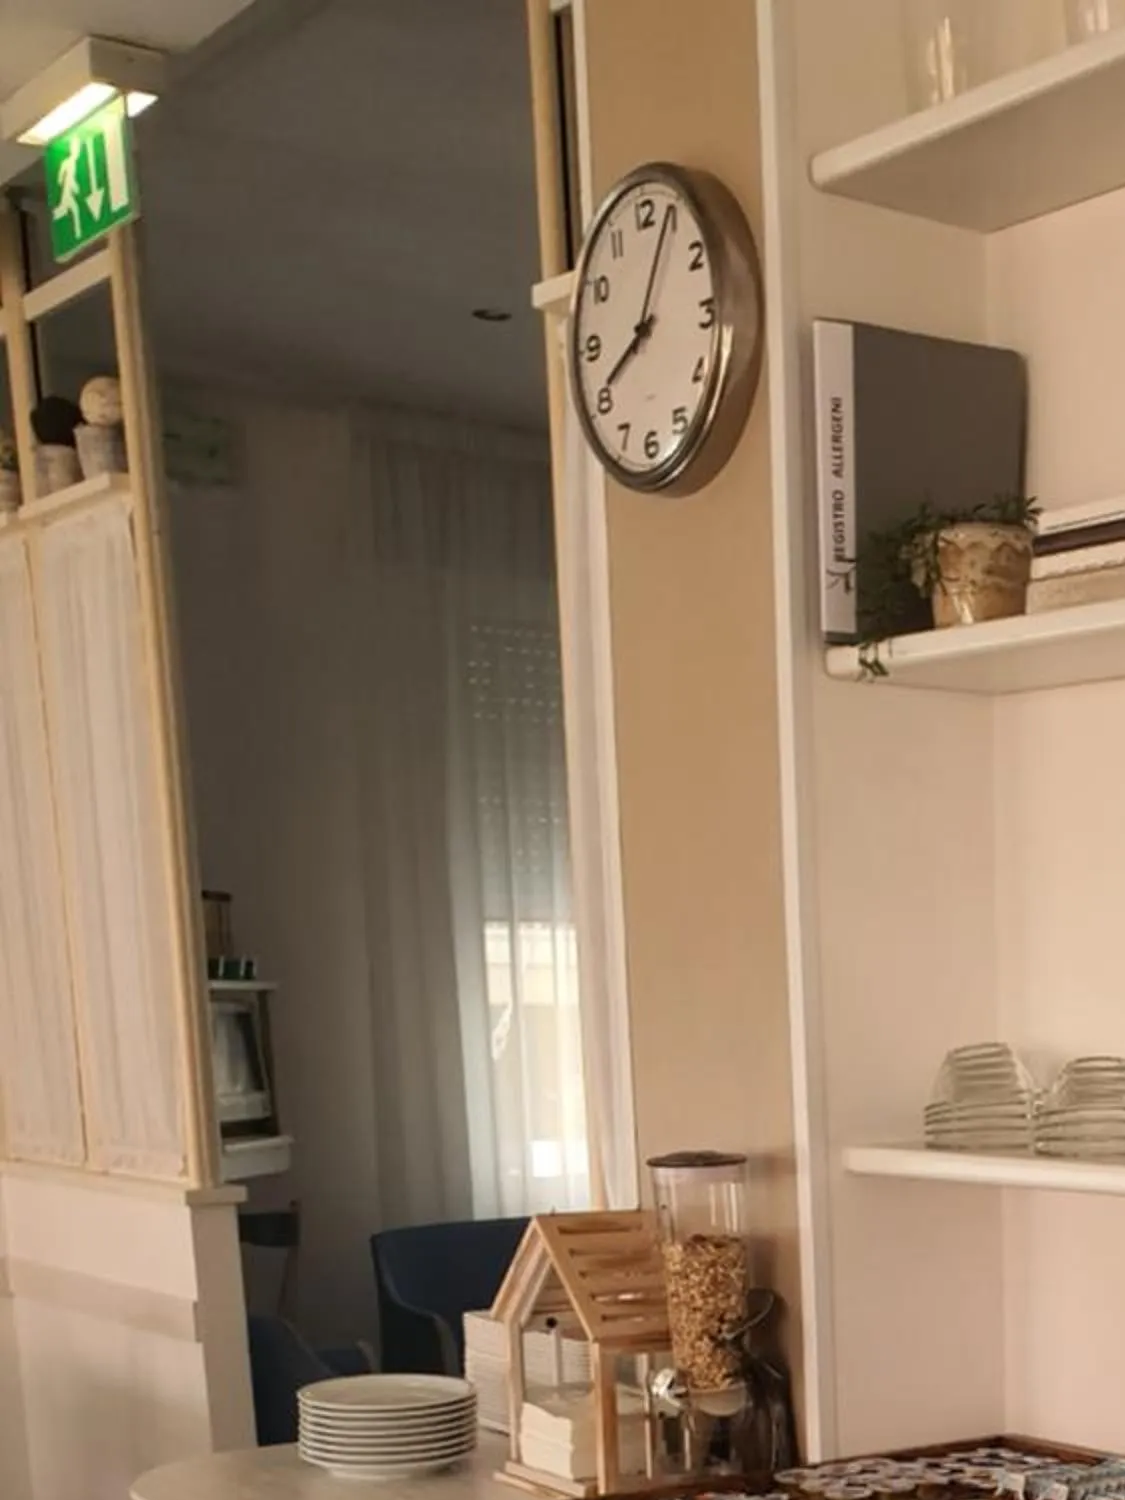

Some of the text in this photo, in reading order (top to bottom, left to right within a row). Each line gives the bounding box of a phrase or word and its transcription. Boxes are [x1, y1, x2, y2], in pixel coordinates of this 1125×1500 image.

[635, 200, 655, 231] 12
[610, 229, 624, 260] 11
[688, 240, 704, 272] 2
[593, 275, 610, 305] 10
[698, 298, 715, 330] 3
[585, 335, 602, 363] 9
[596, 387, 613, 416] 8
[671, 407, 690, 435] 5
[616, 423, 632, 451] 7
[643, 431, 660, 459] 6
[831, 396, 846, 562] REGISTRO ALLERGENI
